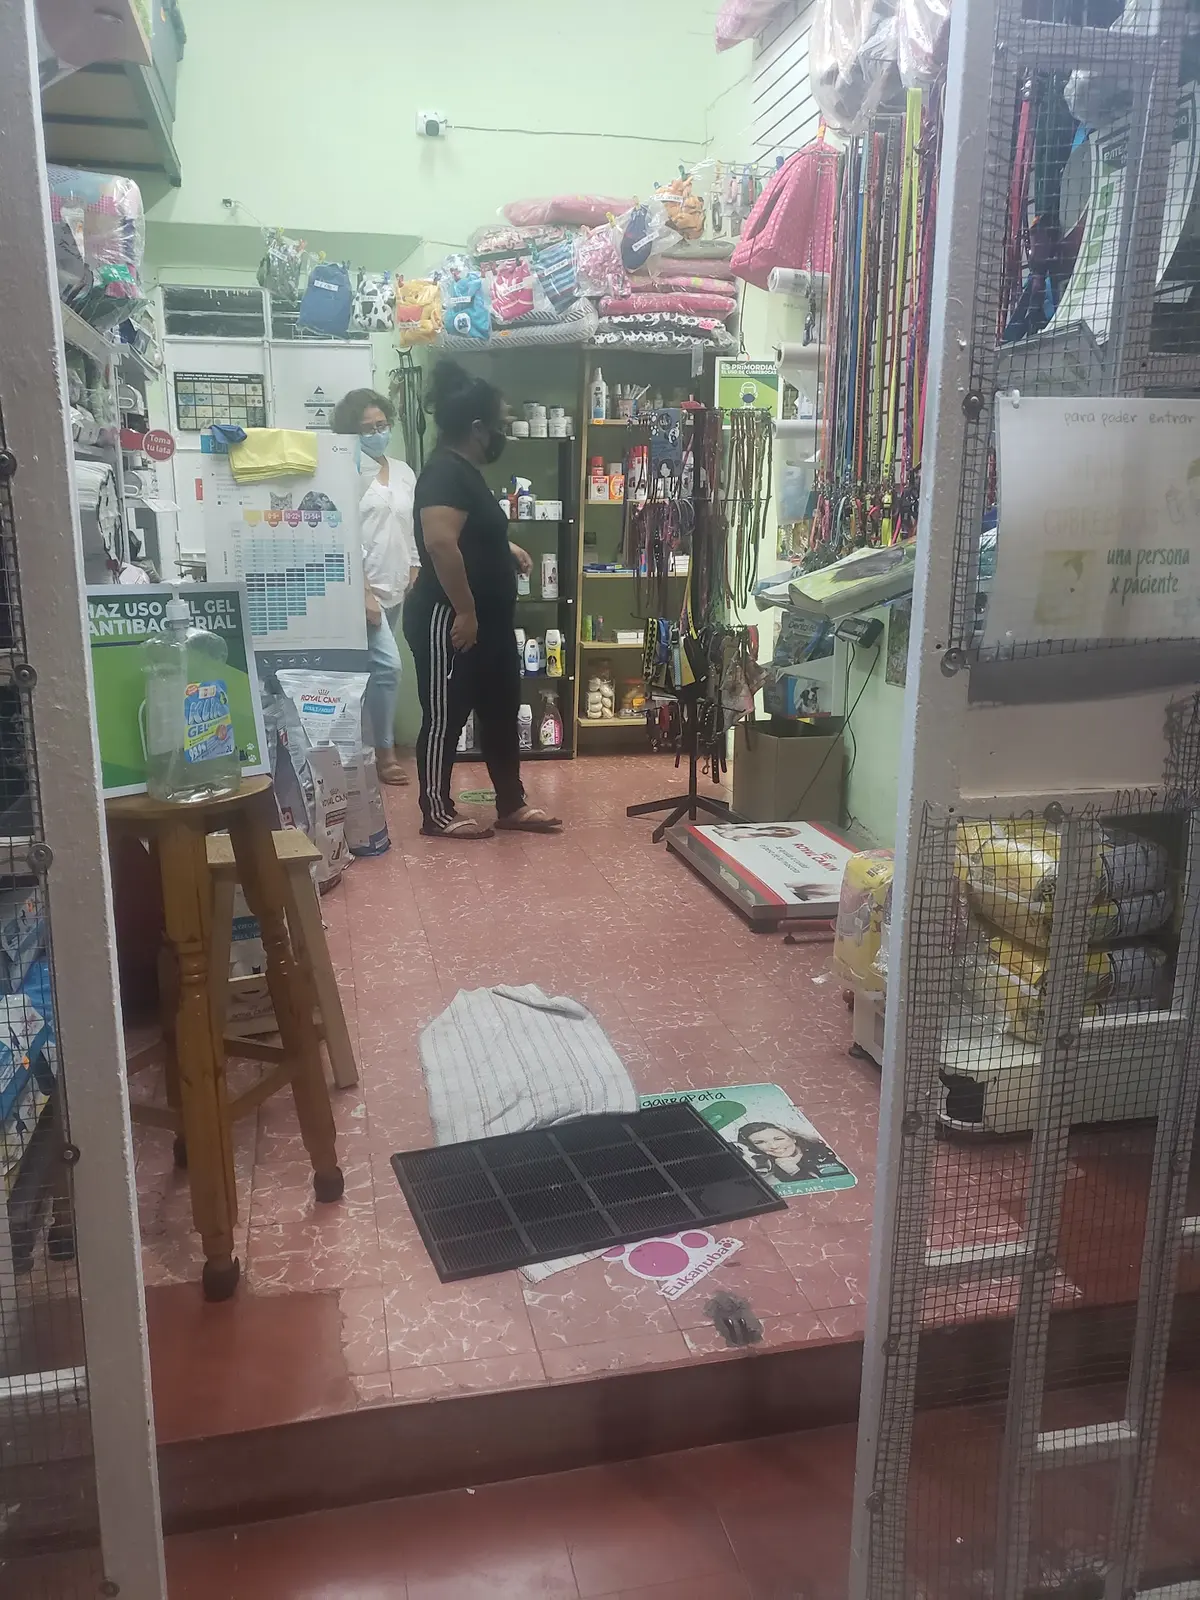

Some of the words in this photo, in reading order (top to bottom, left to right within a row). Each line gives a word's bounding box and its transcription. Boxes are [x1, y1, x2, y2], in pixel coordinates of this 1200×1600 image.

[732, 363, 777, 371] PRIMORDIAL
[1064, 411, 1095, 426] para
[1101, 410, 1138, 428] poder
[1149, 411, 1197, 425] entrar
[149, 433, 171, 445] Toma
[156, 445, 171, 455] lata
[1107, 548, 1131, 565] una
[1135, 548, 1190, 577] persona
[1121, 572, 1179, 606] paciente
[88, 603, 121, 619] HAZ
[125, 601, 163, 616] USO
[204, 599, 236, 613] GEL
[88, 614, 237, 636] ANTIBACRIAL
[301, 694, 322, 703] ROYAL
[188, 723, 210, 738] GEL
[662, 1247, 729, 1296] Eukanuba
